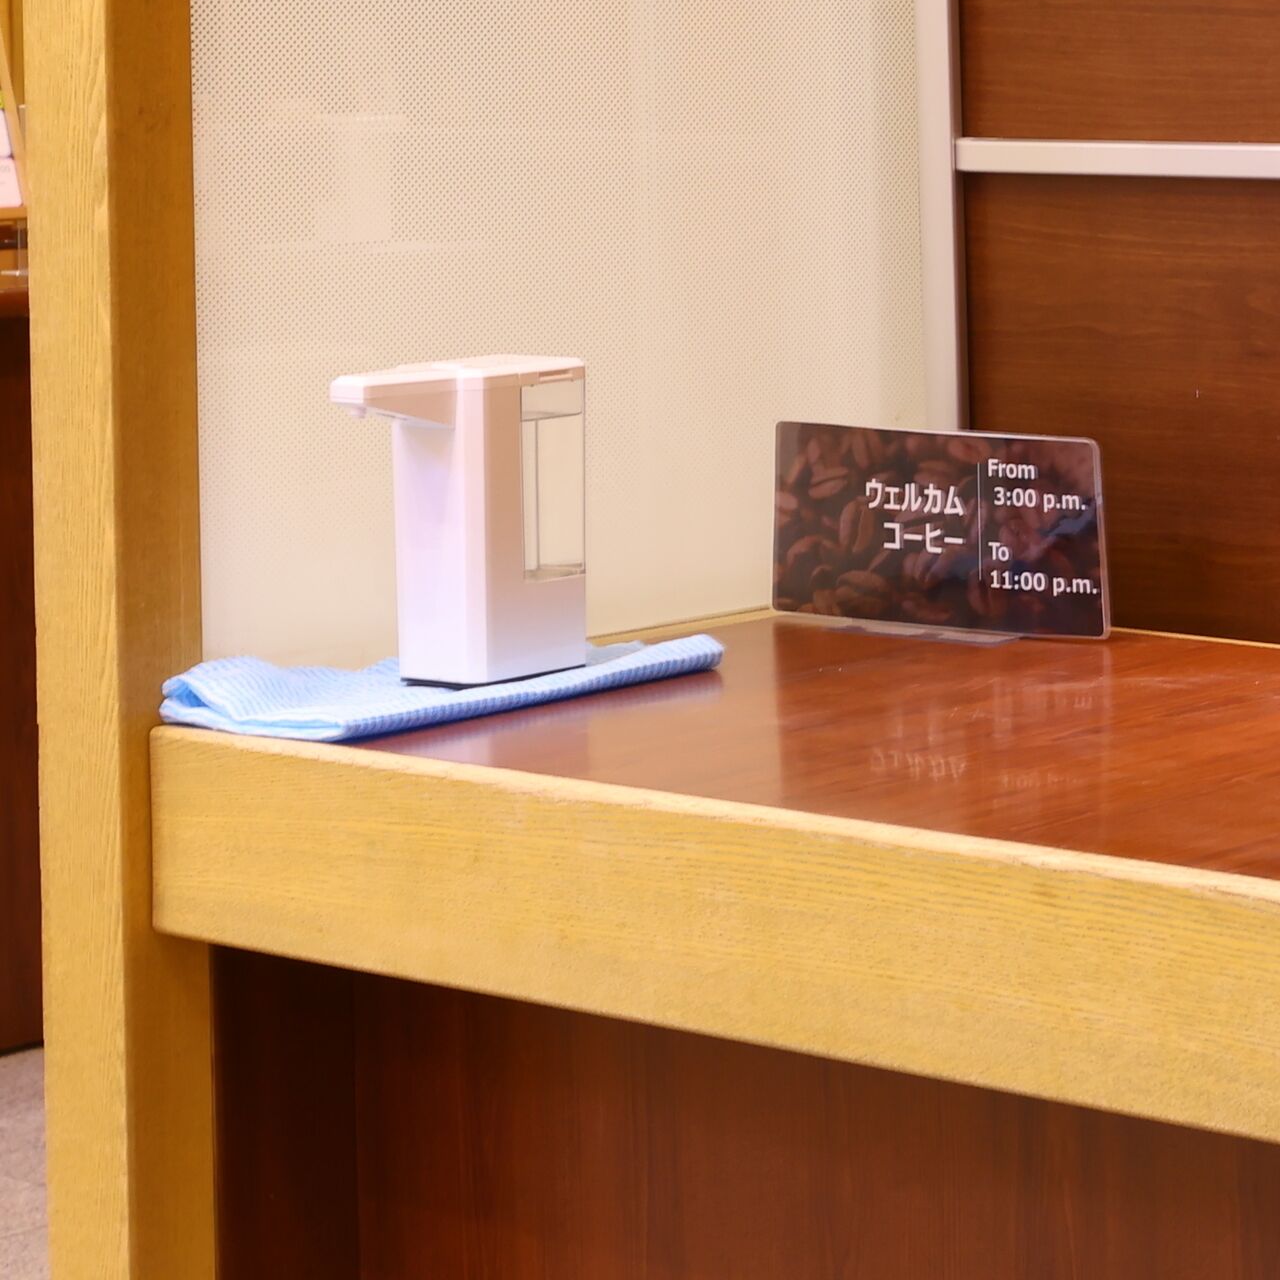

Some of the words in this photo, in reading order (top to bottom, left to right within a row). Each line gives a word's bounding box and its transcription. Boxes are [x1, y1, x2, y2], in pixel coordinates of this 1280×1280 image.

[988, 458, 1037, 480] From
[865, 478, 964, 517] ウェルカム
[993, 486, 1037, 508] 3:00
[1043, 490, 1087, 513] p.m.
[883, 522, 964, 554] コーヒー
[988, 541, 1010, 562] To
[990, 570, 1046, 592] 11:00
[1053, 574, 1098, 597] p.m.
